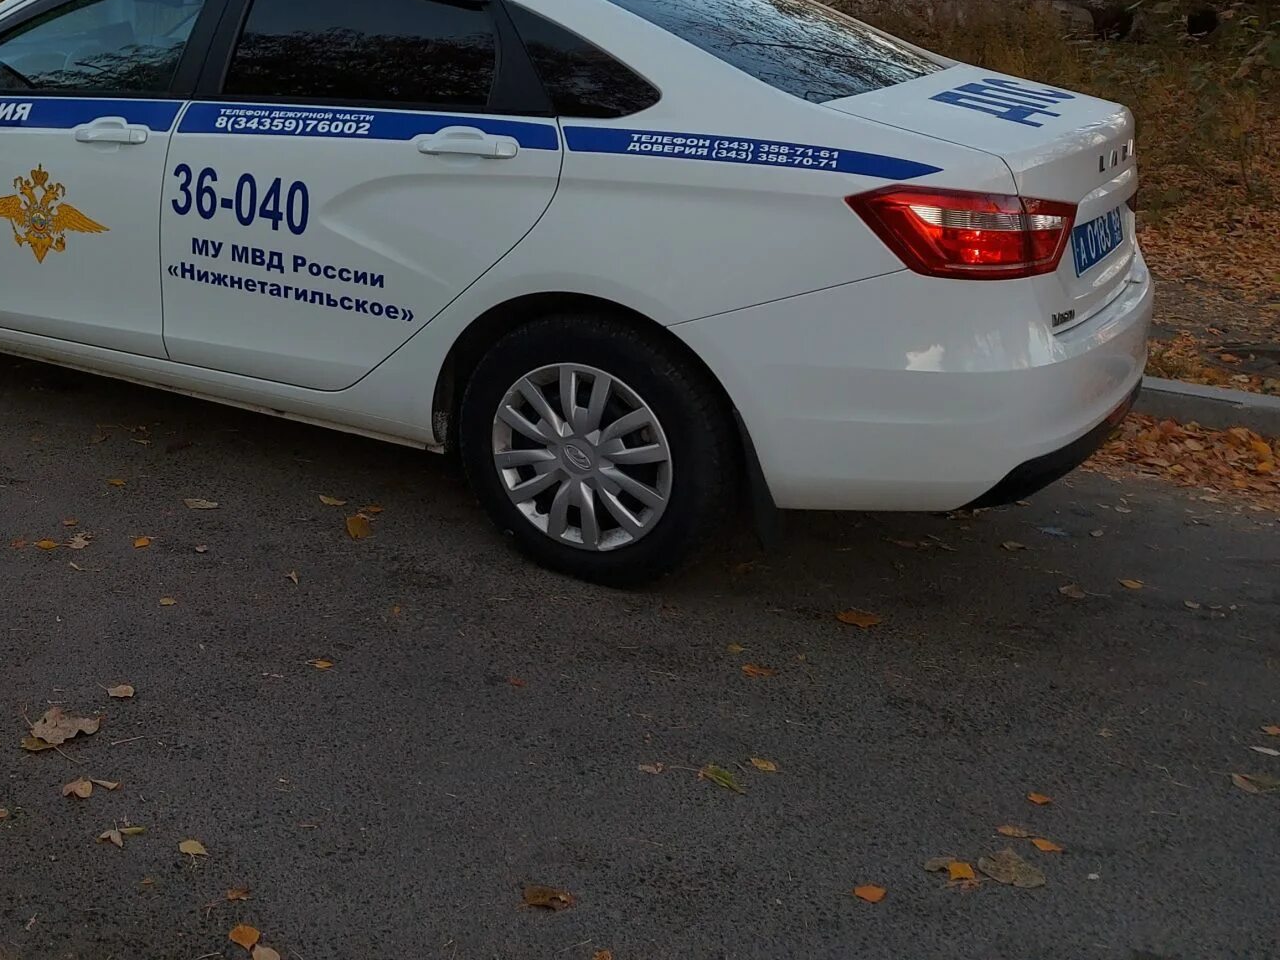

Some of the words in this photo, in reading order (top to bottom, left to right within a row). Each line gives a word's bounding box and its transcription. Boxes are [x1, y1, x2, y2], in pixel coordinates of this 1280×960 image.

[220, 108, 269, 117] ТЕЛЕФОН
[270, 111, 333, 120] ДЕЖУРНОЙ
[336, 113, 375, 121] ЧАСТИ
[928, 78, 1076, 128] ДПС
[215, 116, 371, 135] 8(34359)76002
[627, 142, 709, 156] ДОВЕРИЯ
[712, 149, 752, 162] (343)
[758, 153, 838, 168] 358-70-71
[631, 133, 711, 147] ТЕЛЕФОН
[714, 139, 754, 152] (343)
[759, 144, 839, 159] 358-71-61
[172, 163, 310, 236] 36-040
[191, 237, 223, 258] МУ
[231, 244, 285, 274] МВД
[292, 255, 385, 289] России
[167, 262, 415, 322] «Нижнетагильское»
